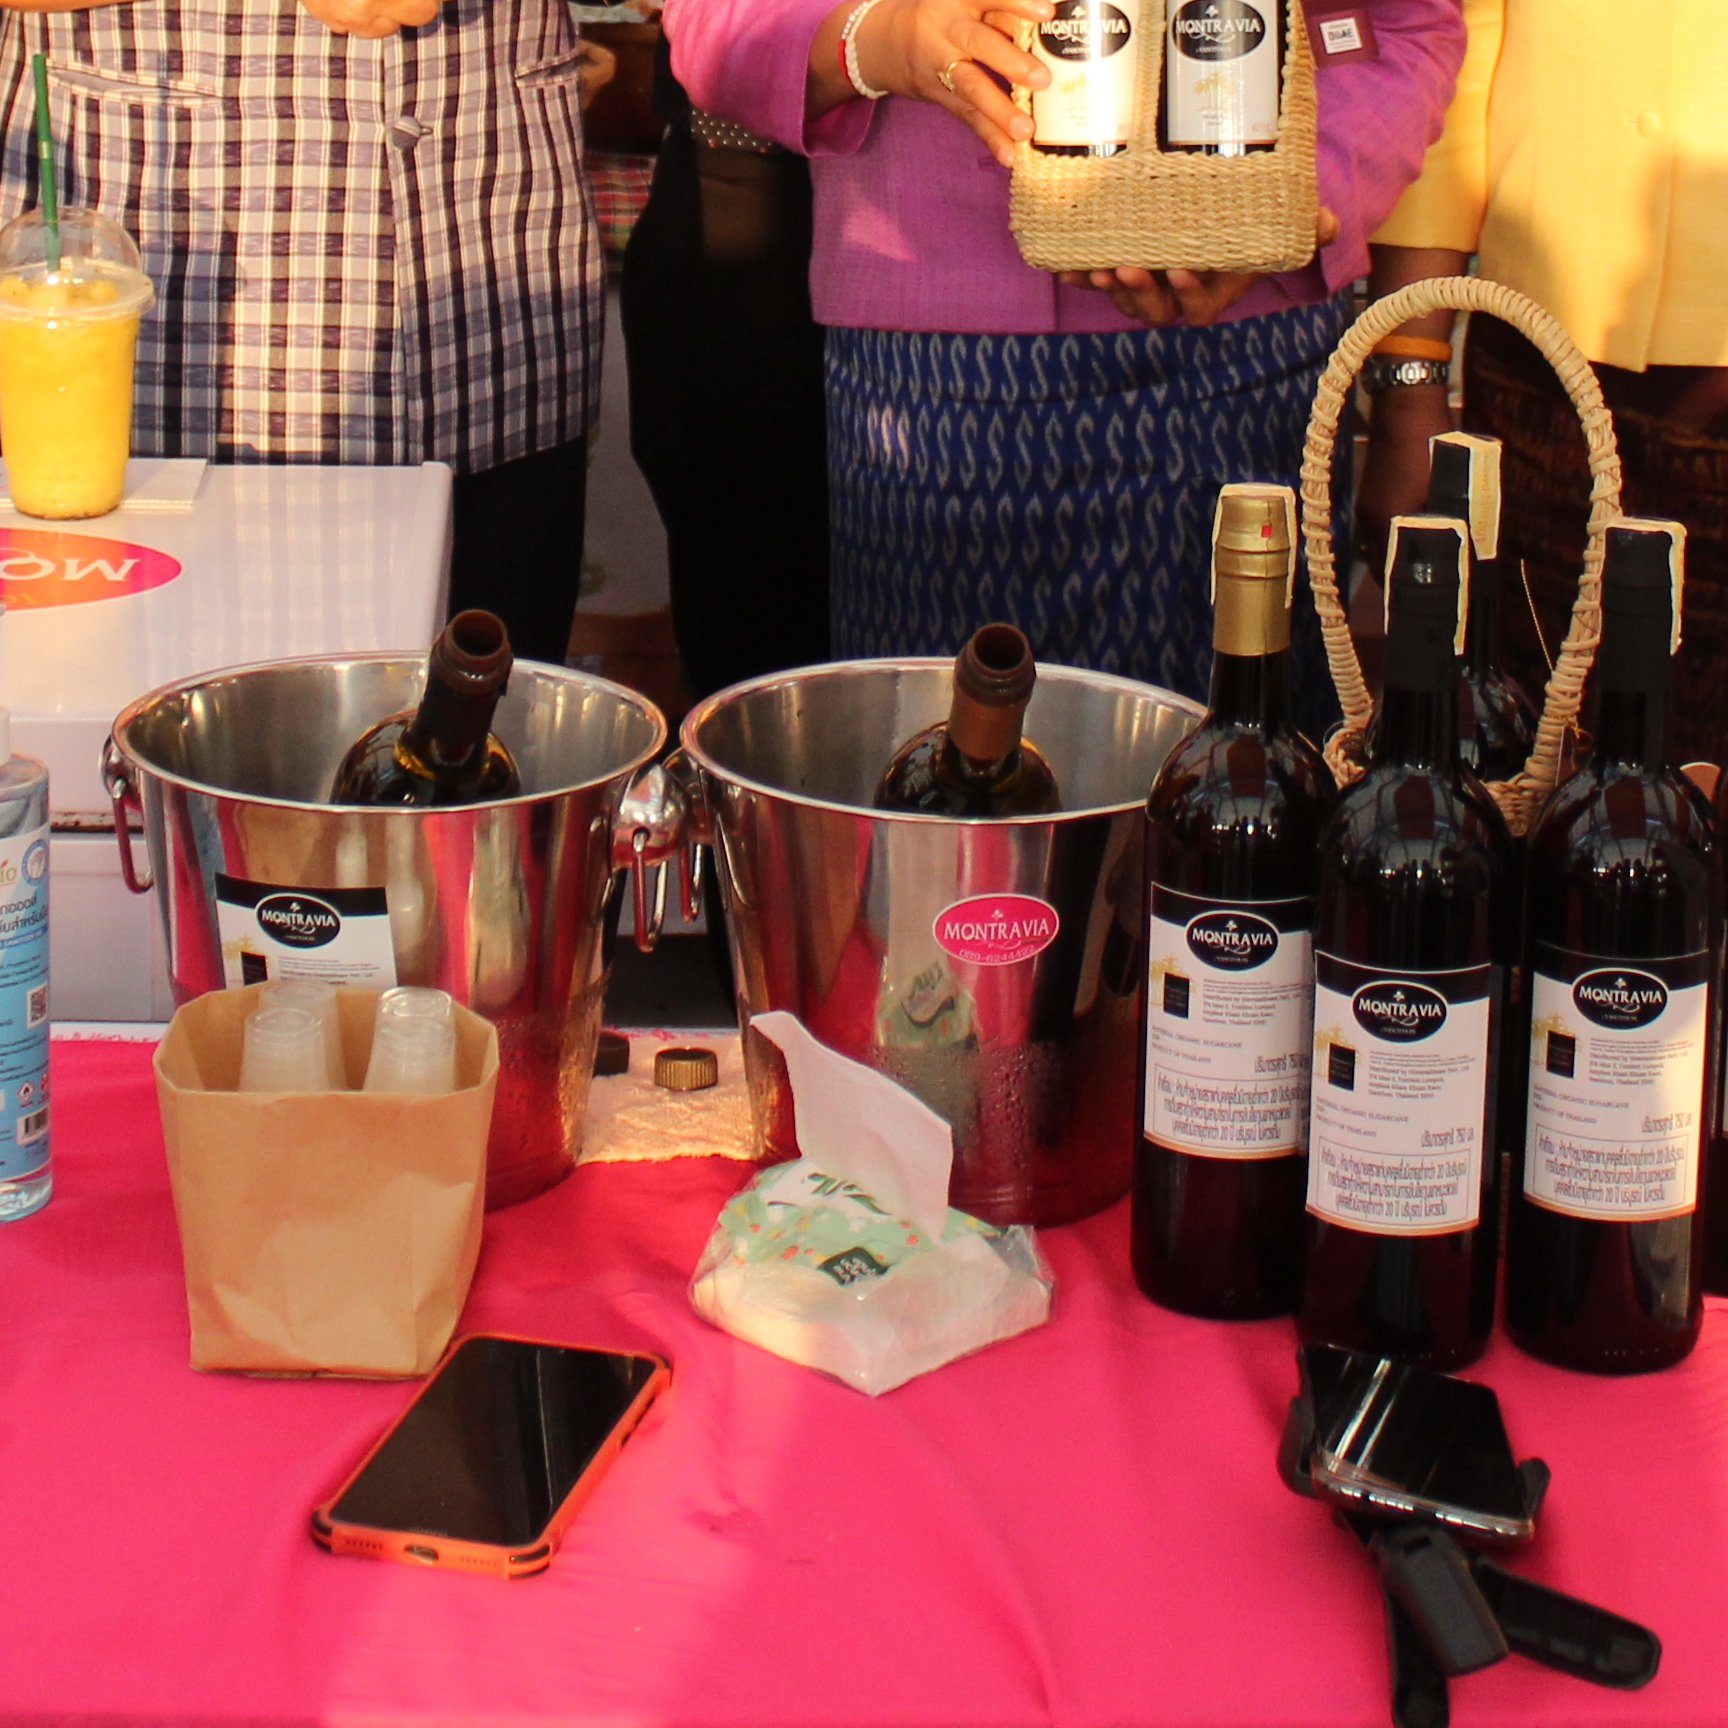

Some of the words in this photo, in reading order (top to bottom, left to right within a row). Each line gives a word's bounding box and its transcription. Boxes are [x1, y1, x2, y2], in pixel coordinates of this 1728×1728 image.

[1040, 19, 1127, 35] MONTRVIA
[1175, 18, 1261, 35] MONTRAVIA
[261, 908, 337, 928] MONTRAVIA
[943, 918, 1051, 941] MONTRAVIA
[1192, 928, 1273, 948] MONTRAVIA
[1578, 985, 1663, 1004] MONTRAVIA
[1358, 997, 1442, 1017] MONTRAVIA
